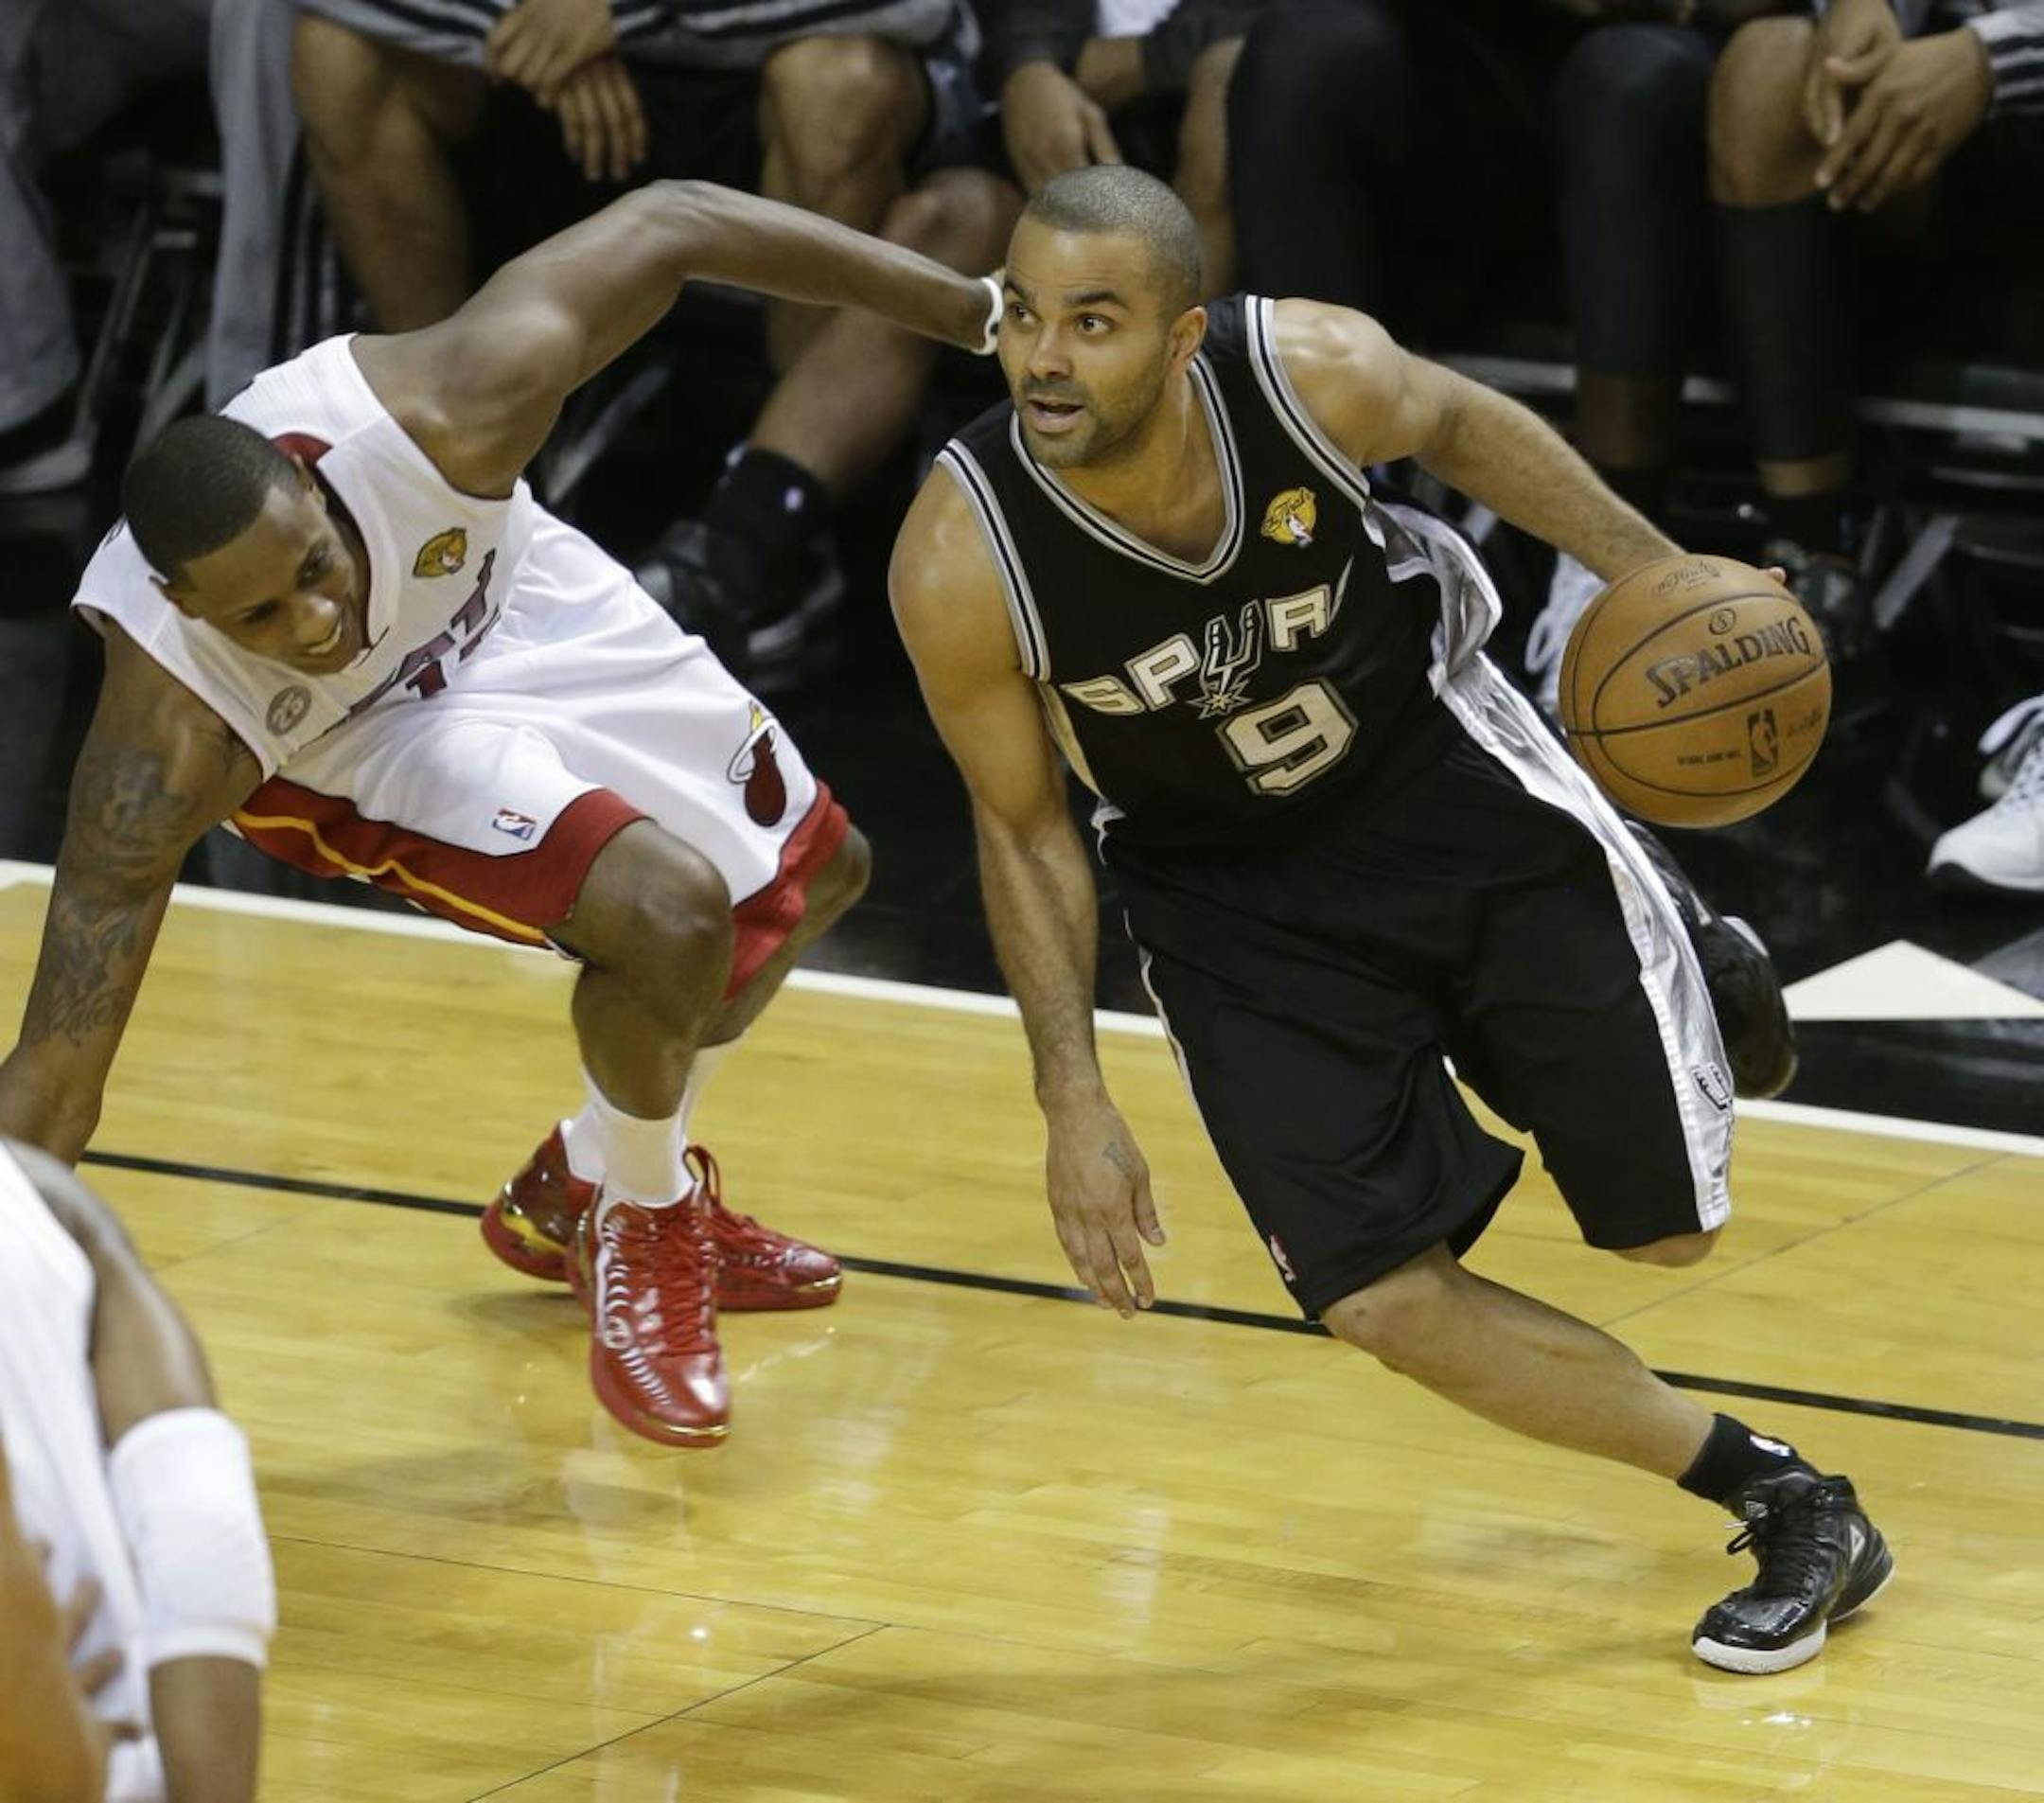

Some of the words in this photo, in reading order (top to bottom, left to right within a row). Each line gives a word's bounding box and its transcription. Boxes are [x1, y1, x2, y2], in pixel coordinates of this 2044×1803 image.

[1060, 557, 1354, 719] SPUR
[1646, 616, 1812, 709] SPALDING
[1215, 677, 1359, 797] 9
